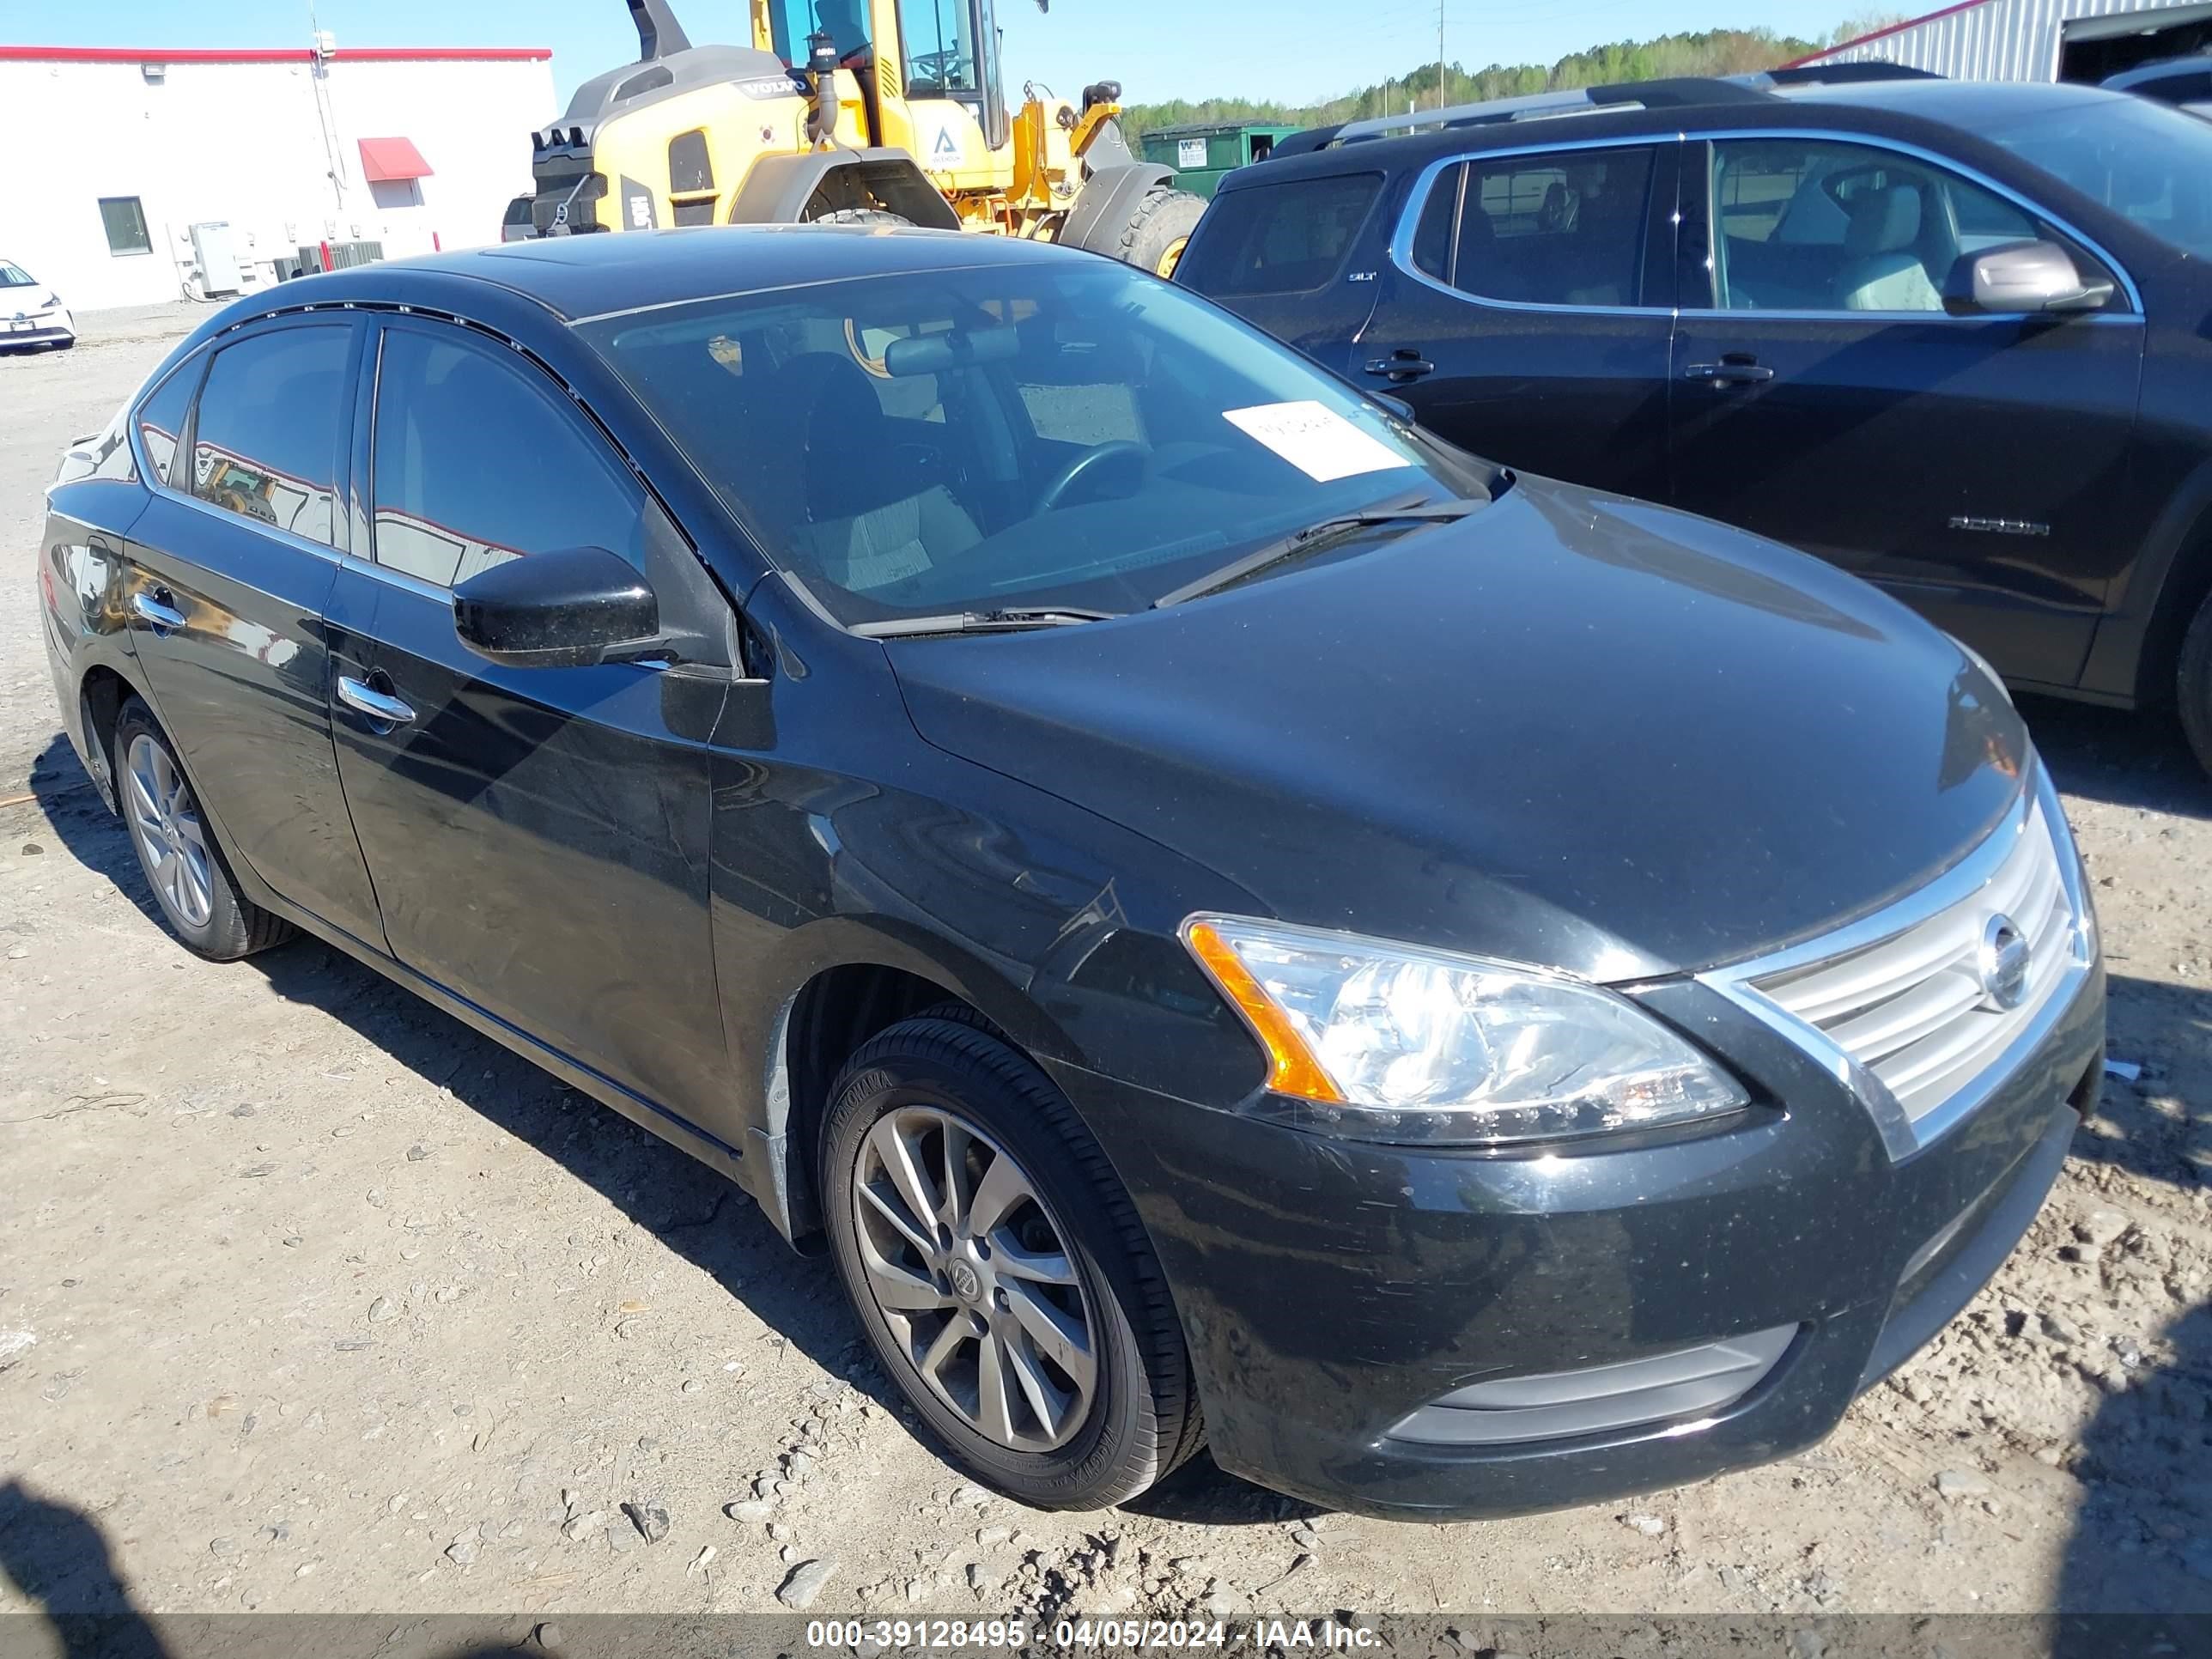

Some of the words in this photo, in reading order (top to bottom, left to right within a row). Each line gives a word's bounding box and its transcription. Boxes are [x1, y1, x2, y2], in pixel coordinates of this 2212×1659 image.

[742, 80, 807, 94] VOLVO
[1348, 270, 1377, 282] SLT
[830, 1070, 893, 1129] YOKOHAMA
